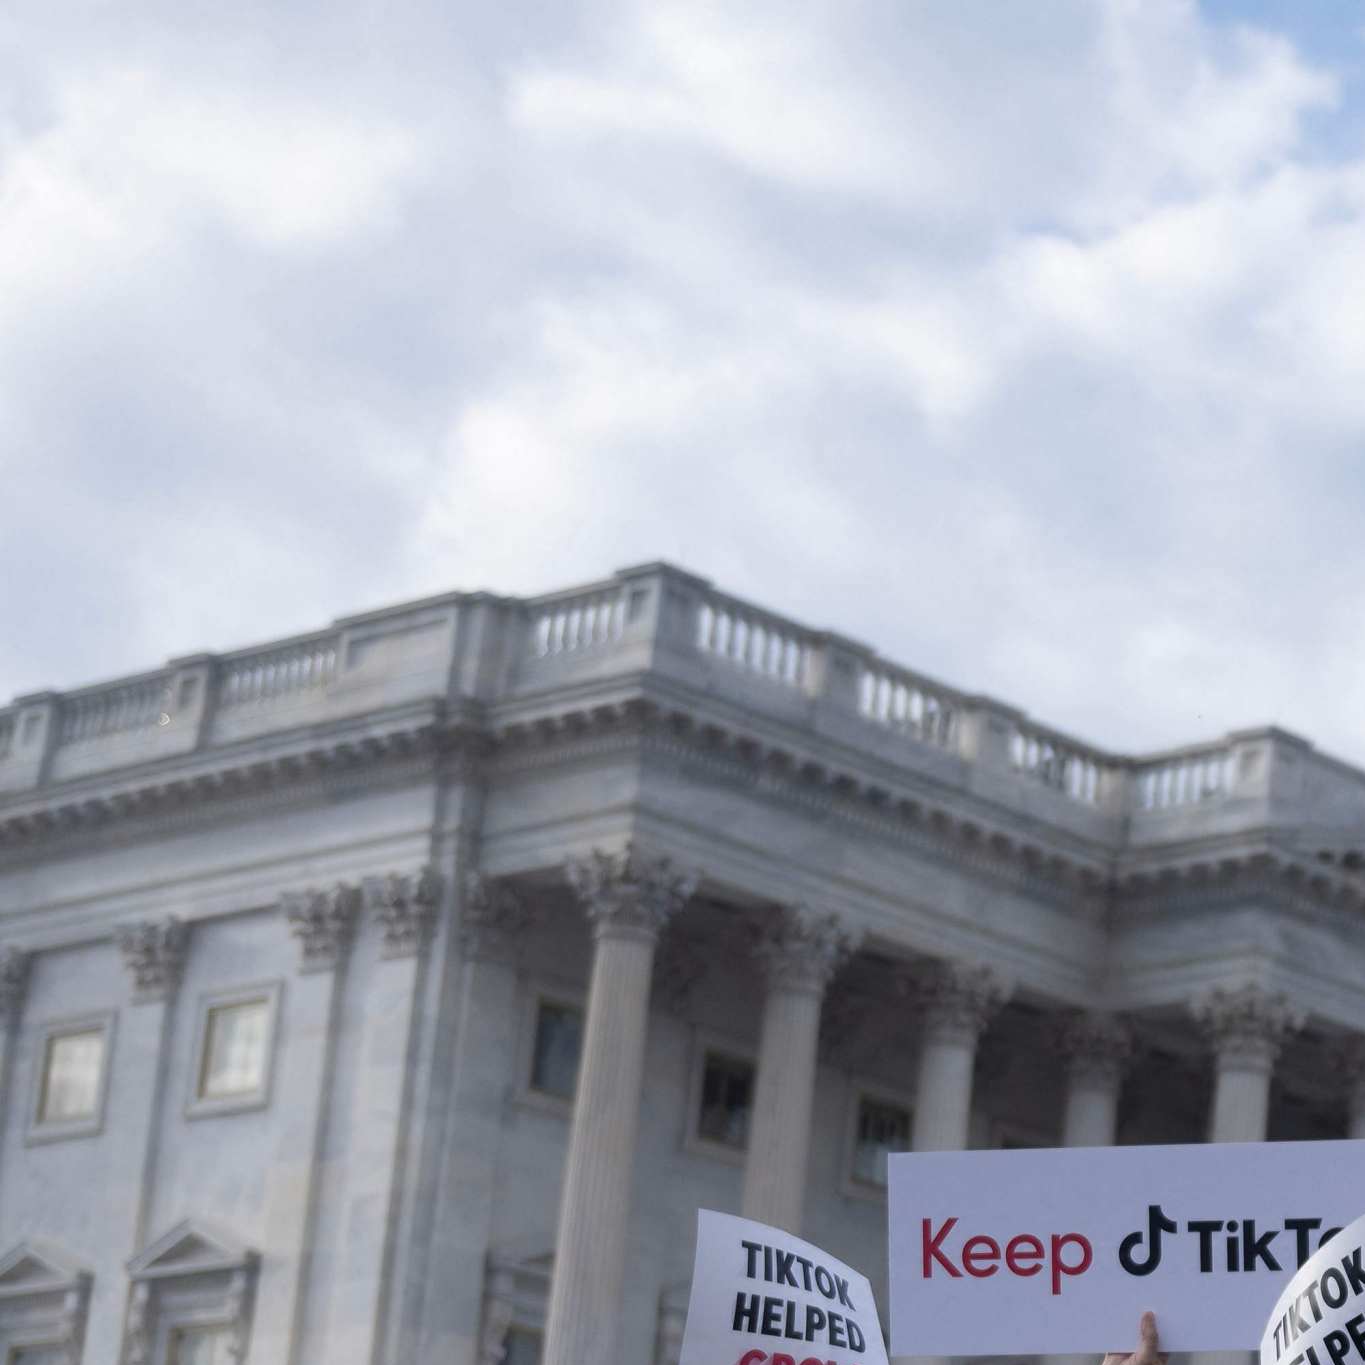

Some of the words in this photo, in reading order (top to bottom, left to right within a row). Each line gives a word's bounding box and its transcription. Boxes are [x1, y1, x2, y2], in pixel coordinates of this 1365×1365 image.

[741, 1240, 856, 1311] TIKTOK
[922, 1217, 1094, 1295] Keep
[1188, 1217, 1344, 1273] TikT
[732, 1291, 866, 1353] HELPED
